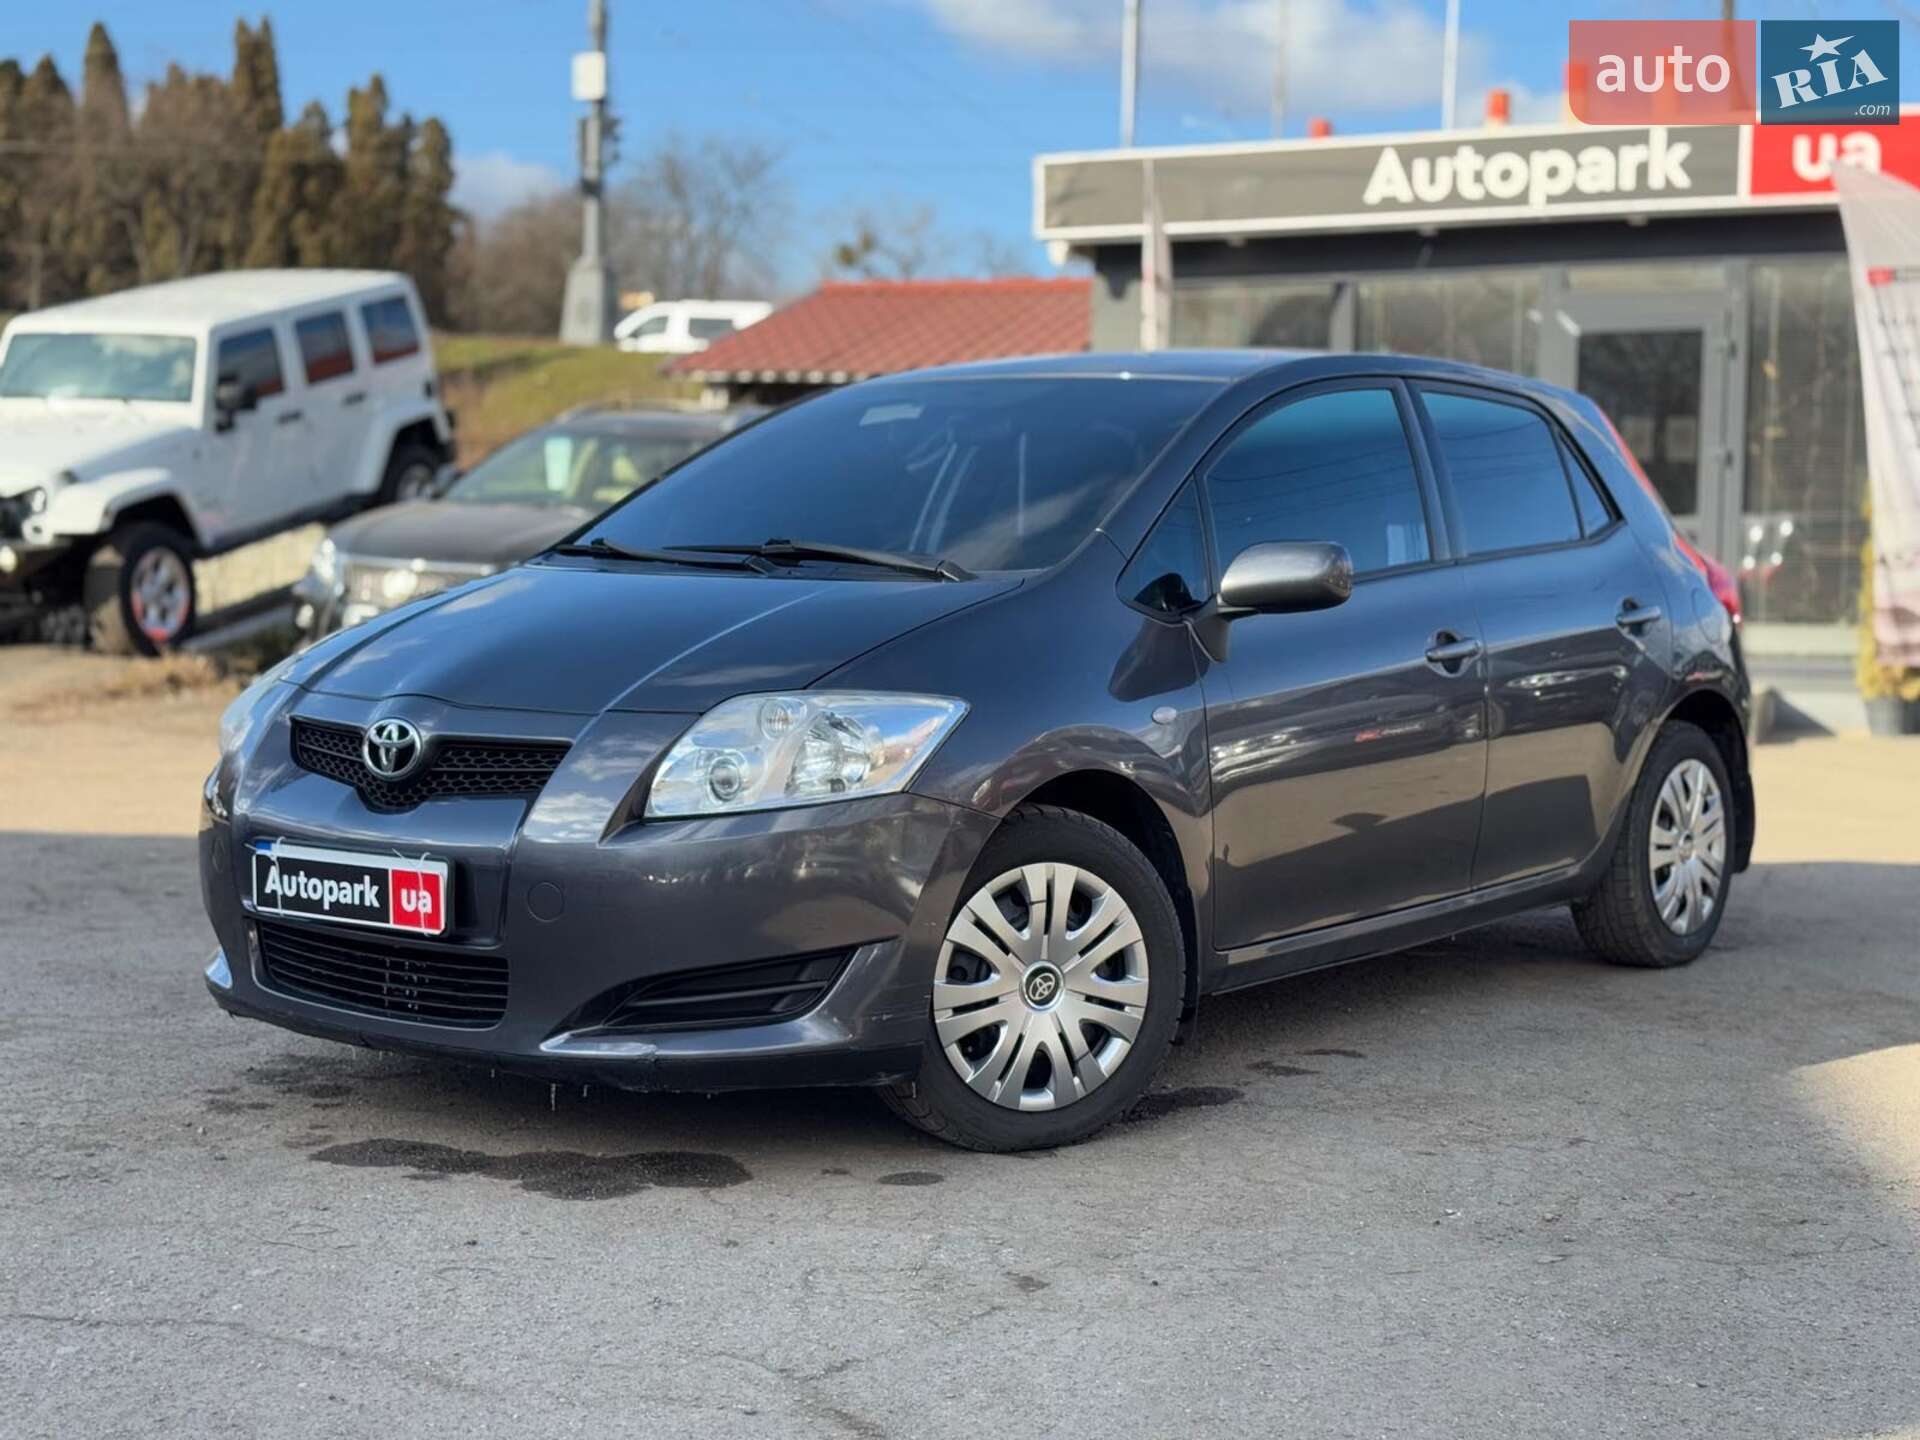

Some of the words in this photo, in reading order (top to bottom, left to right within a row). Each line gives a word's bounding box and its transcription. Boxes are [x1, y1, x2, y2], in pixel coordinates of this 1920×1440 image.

[1362, 127, 1692, 206] Autopark
[1792, 131, 1881, 181] ua
[264, 865, 380, 911] Autopark
[401, 887, 433, 914] ua
